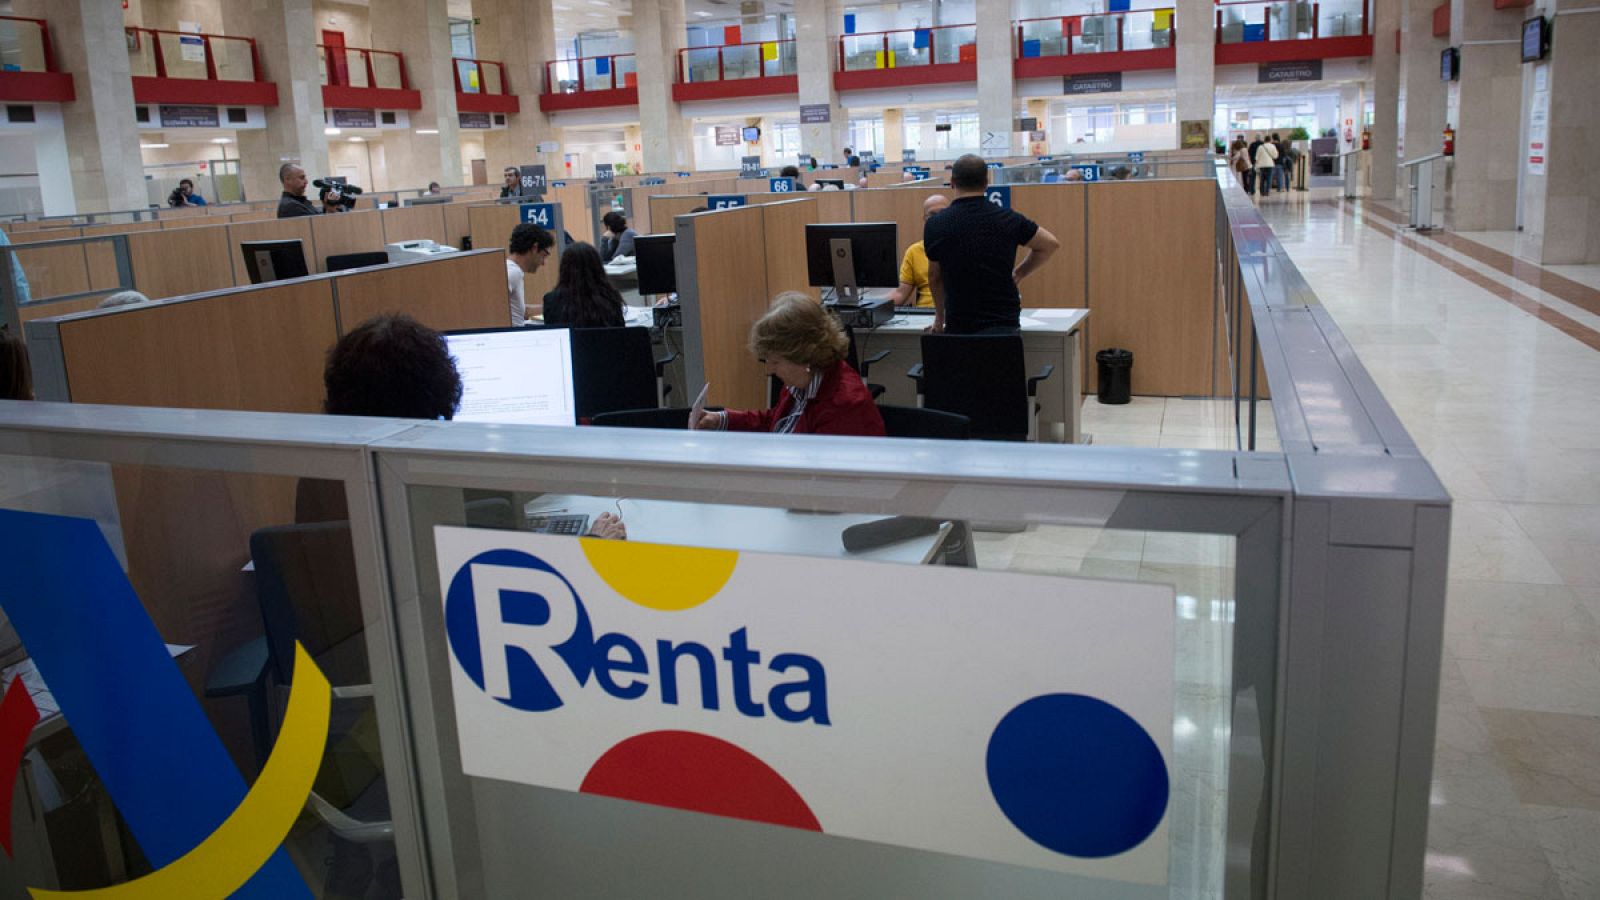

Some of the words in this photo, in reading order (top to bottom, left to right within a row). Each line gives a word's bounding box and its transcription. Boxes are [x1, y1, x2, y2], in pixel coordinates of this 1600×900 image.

[1269, 70, 1313, 79] CATASTRO
[1072, 82, 1112, 91] CATASTRO
[522, 175, 545, 188] 66-71
[774, 180, 788, 192] 66
[527, 207, 549, 226] 54
[469, 560, 832, 727] Renta
